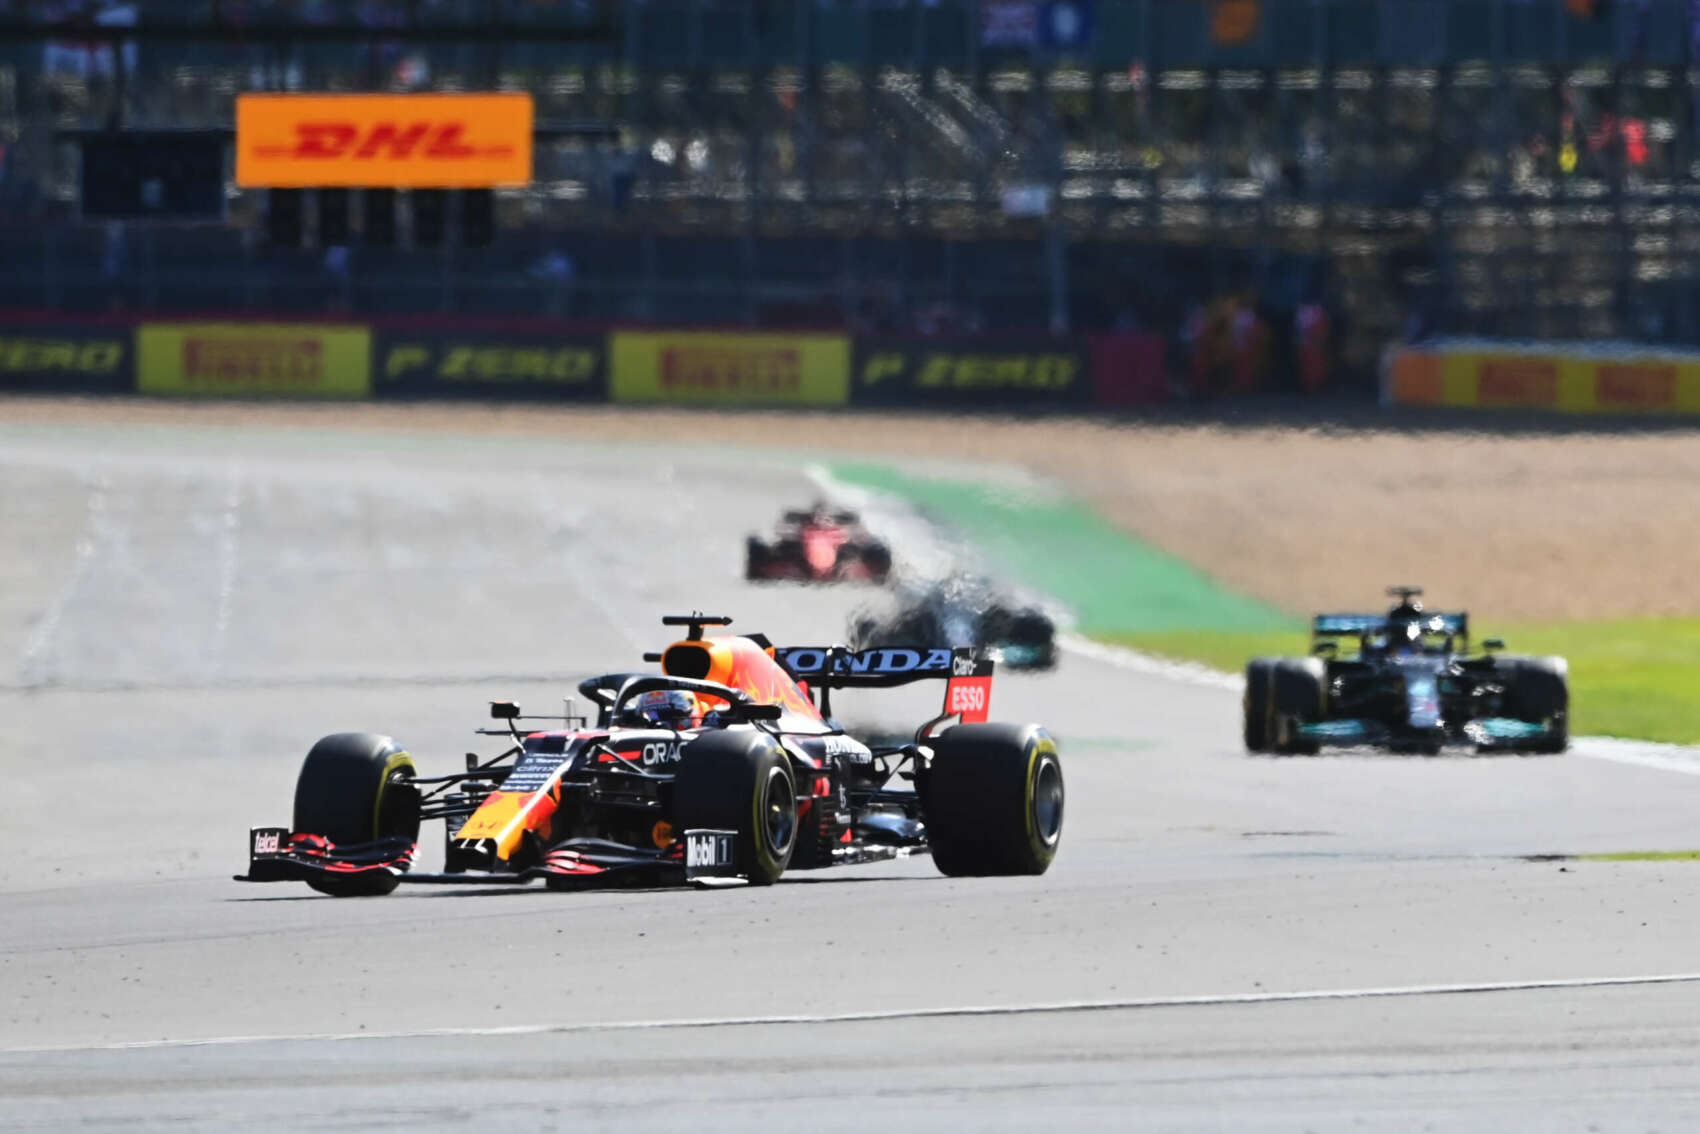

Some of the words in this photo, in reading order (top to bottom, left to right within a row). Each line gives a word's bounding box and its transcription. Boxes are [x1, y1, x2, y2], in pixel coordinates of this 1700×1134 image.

[294, 121, 476, 160] DHL
[0, 338, 122, 374] ERO
[386, 346, 430, 378] P
[862, 353, 906, 385] P
[779, 649, 950, 672] ONDA
[952, 686, 984, 711] ESSO
[687, 835, 716, 868] Mobil
[720, 838, 728, 863] 1
